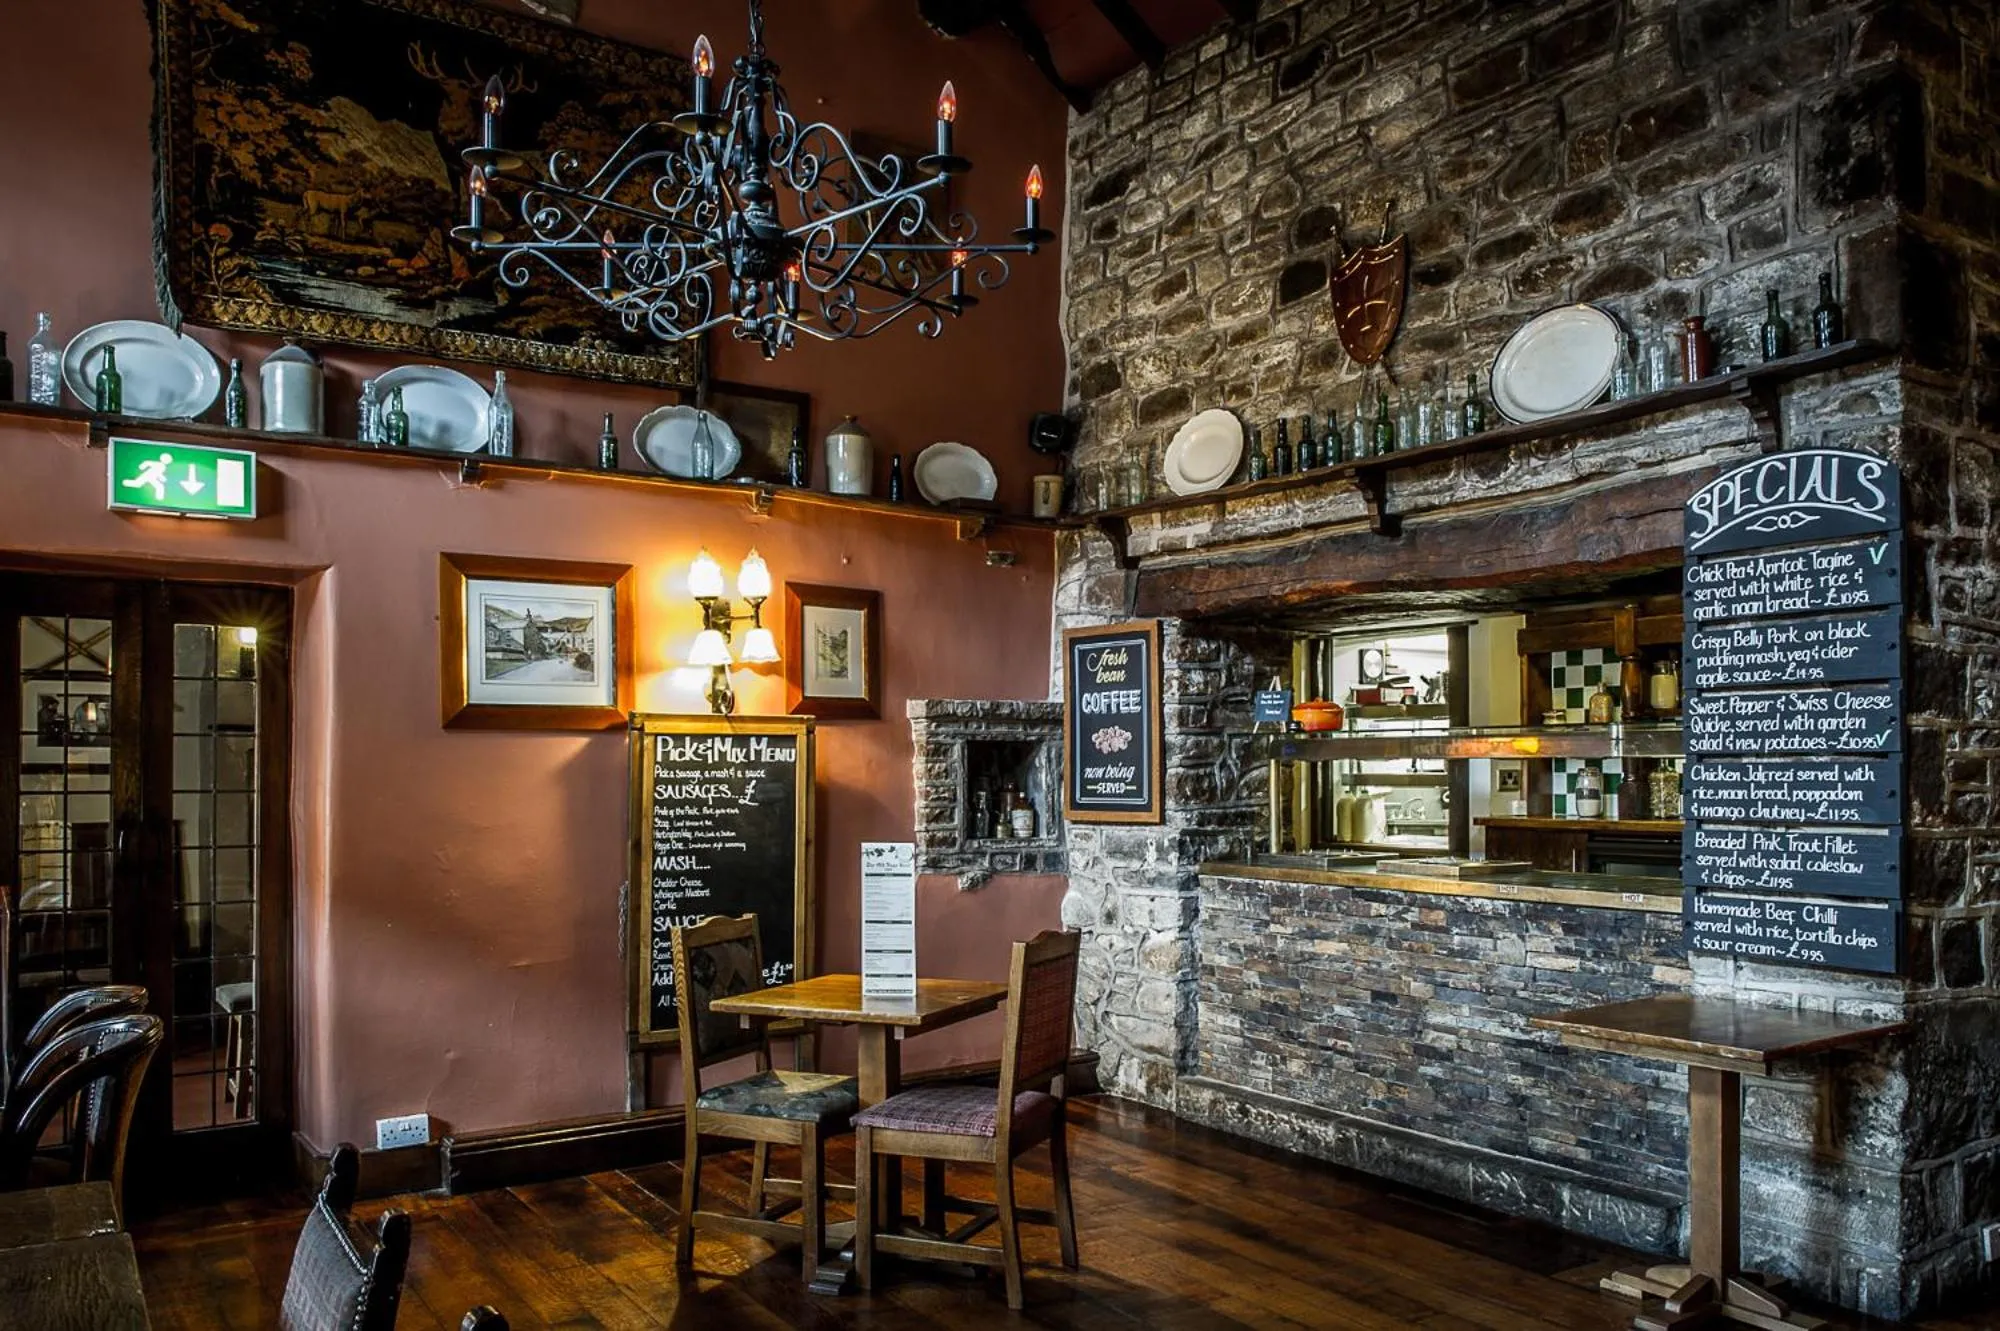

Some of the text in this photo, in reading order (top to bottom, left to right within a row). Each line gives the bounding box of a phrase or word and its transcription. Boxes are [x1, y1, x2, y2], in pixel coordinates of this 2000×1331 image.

[1690, 456, 1886, 538] SPECIALS
[1688, 565, 1724, 583] Chick
[1726, 563, 1744, 579] Pea
[1756, 558, 1807, 578] Apricot
[1809, 551, 1855, 574] Tagine
[1694, 569, 1863, 602] served with white rice &
[1693, 600, 1729, 620] garlic
[1732, 598, 1763, 614] naan
[1692, 621, 1871, 651] Crispy Belly Pork on black
[1697, 651, 1744, 670] pudding
[1788, 646, 1810, 664] veg
[1811, 645, 1820, 660] &
[1821, 644, 1859, 659] cider
[1096, 670, 1126, 684] bean
[1696, 668, 1731, 687] apple
[1082, 689, 1142, 715] COFFEE
[1689, 692, 1893, 716] Sweet Pepper & Swiss Cheese
[1736, 715, 1780, 732] served
[1783, 714, 1814, 730] with
[1817, 715, 1866, 733] garden
[1689, 733, 1723, 751] salad
[1725, 734, 1734, 750] &
[1733, 737, 1761, 751] new
[1084, 762, 1135, 782] now being
[1691, 764, 1875, 785] Chicken Jalfrezi served with
[1097, 782, 1125, 794] SERVED
[1718, 788, 1747, 800] naan
[1793, 783, 1863, 803] poppadom
[1691, 804, 1700, 818] &
[1701, 805, 1745, 821] mango
[1695, 832, 1858, 854] Breaded Pink Trout Fillet
[1696, 852, 1737, 868] served
[1738, 854, 1767, 869] with
[1806, 856, 1863, 874] coleslaw
[1701, 868, 1709, 884] &
[1624, 894, 1640, 902] HOT
[1694, 897, 1839, 925] Homemade Beef Chilli
[1693, 934, 1701, 948] &
[1702, 937, 1733, 950] sour
[1694, 920, 1732, 934] served
[1735, 922, 1763, 937] with
[1795, 926, 1842, 945] tortilla
[1845, 928, 1878, 949] chips
